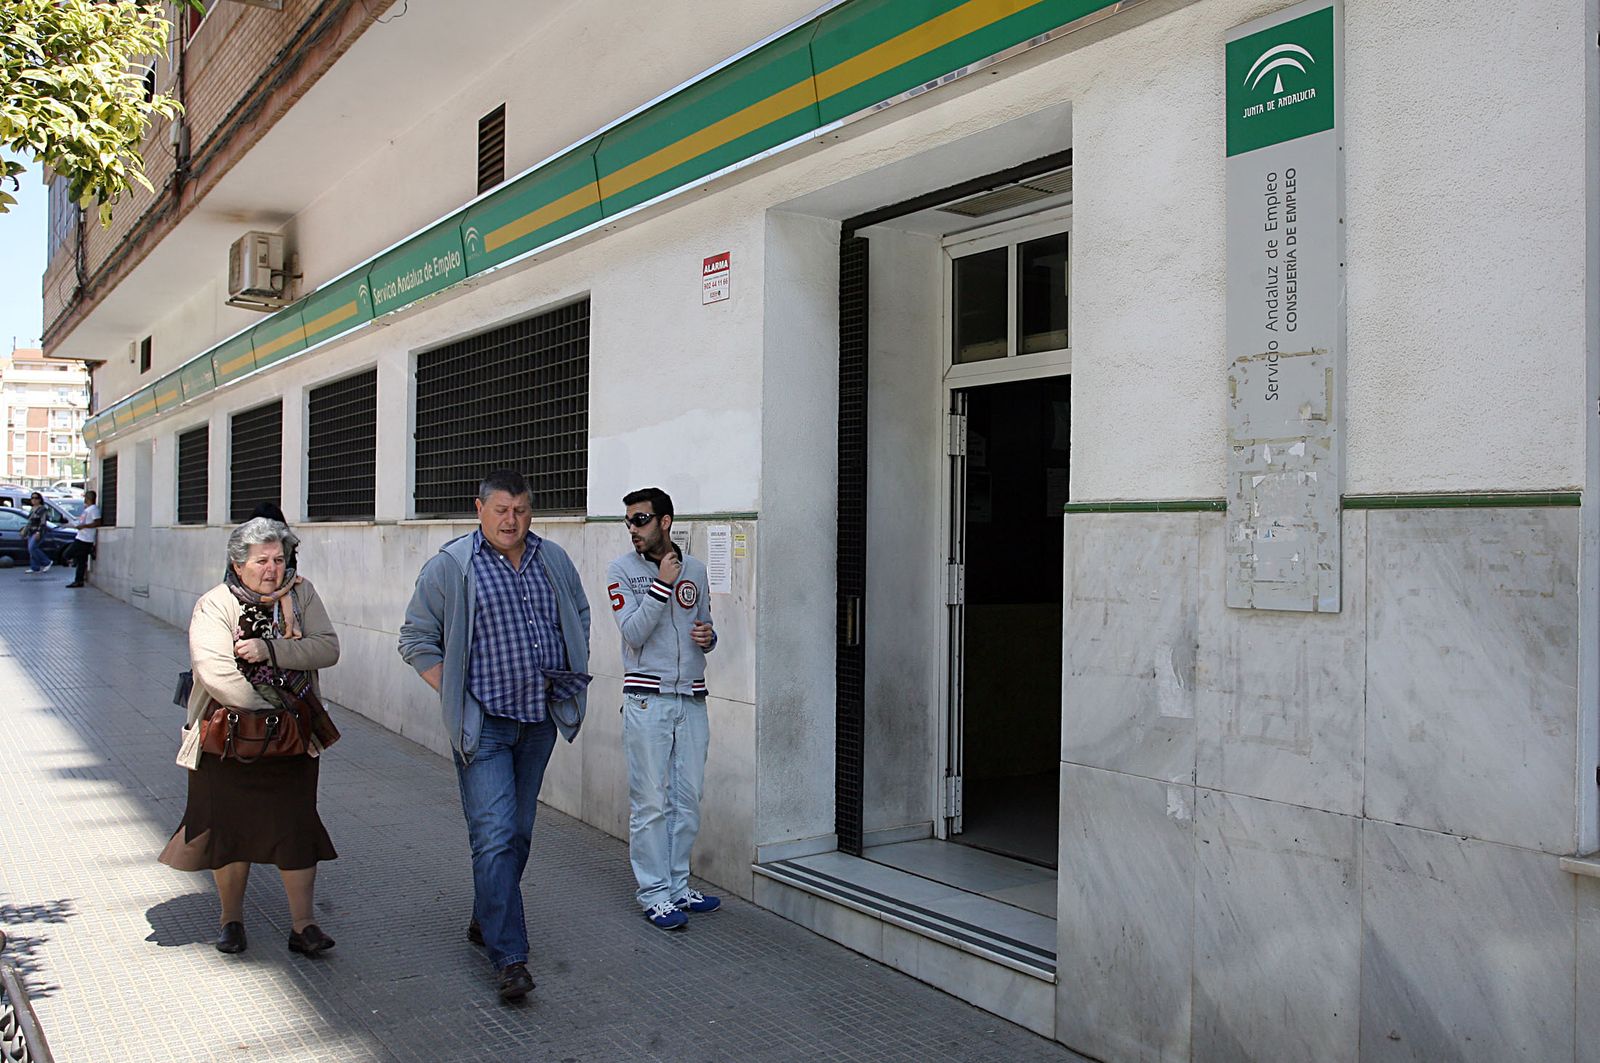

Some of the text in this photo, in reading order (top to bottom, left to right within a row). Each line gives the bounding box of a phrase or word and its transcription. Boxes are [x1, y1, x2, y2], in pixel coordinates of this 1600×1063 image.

[1242, 104, 1264, 118] JUNTA
[1266, 100, 1275, 111] DE
[703, 260, 728, 274] ALARMA
[1283, 167, 1297, 332] CONSEJERÍA DE EMPLEO
[373, 251, 461, 305] Servicio Andaluz de Empleo
[1265, 171, 1281, 401] Servicio Andaluz de Empleo
[607, 582, 625, 611] 5
